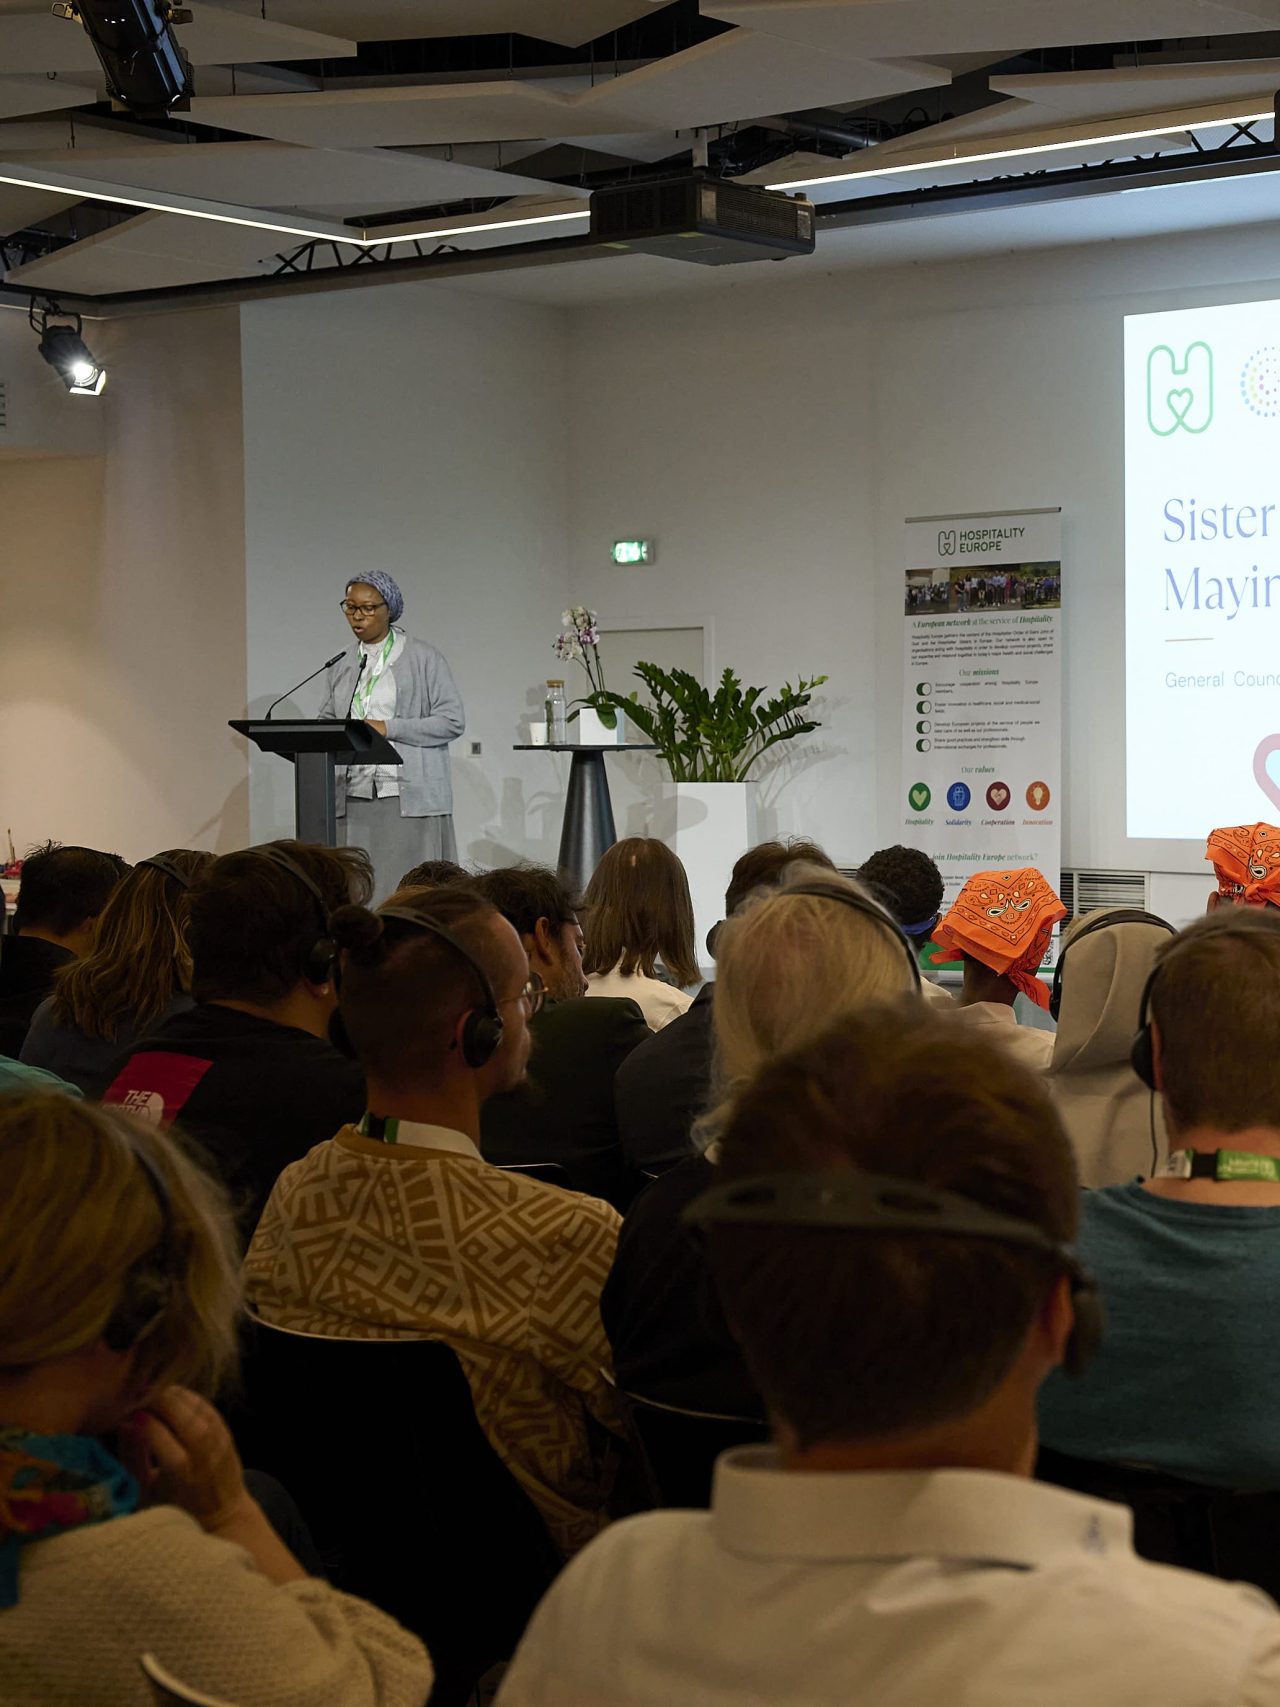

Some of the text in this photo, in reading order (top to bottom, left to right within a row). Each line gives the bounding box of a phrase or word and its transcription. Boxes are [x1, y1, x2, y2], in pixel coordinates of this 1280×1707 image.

[1163, 498, 1276, 543] Sister
[959, 527, 1025, 541] HOSPITALITY
[959, 541, 1002, 553] EUROPE
[1165, 672, 1225, 688] General
[981, 819, 1015, 827] Cooperation
[947, 853, 981, 862] Hospitality
[983, 853, 1006, 862] Europe
[123, 1090, 152, 1105] THE
